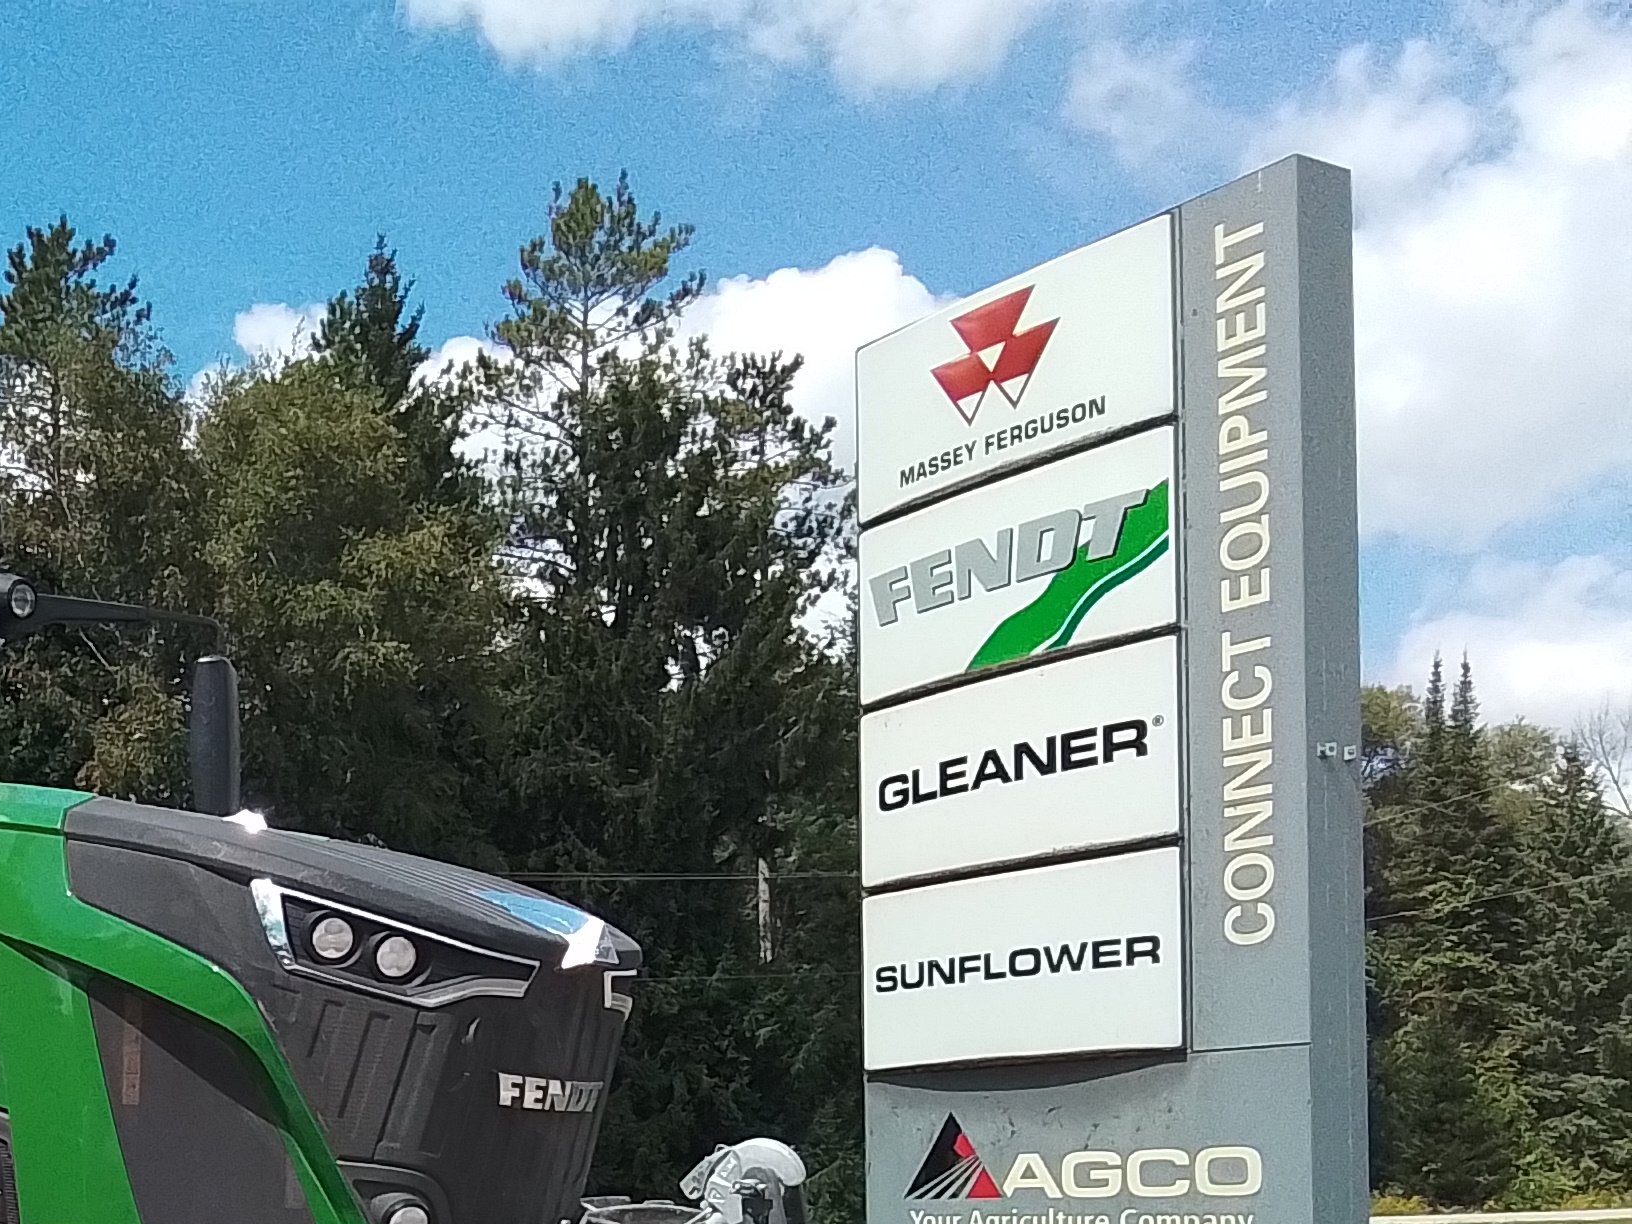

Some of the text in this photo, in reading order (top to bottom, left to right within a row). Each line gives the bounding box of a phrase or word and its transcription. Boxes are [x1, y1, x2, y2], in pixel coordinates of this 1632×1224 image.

[899, 395, 1106, 488] MASSEY FERGUSON
[868, 488, 1150, 627] FENDT
[1214, 222, 1276, 946] CONNECT EQUIPMENT
[874, 934, 1162, 995] SUNFLOWER
[497, 1071, 605, 1113] FENDT
[1002, 1145, 1263, 1199] AGCO
